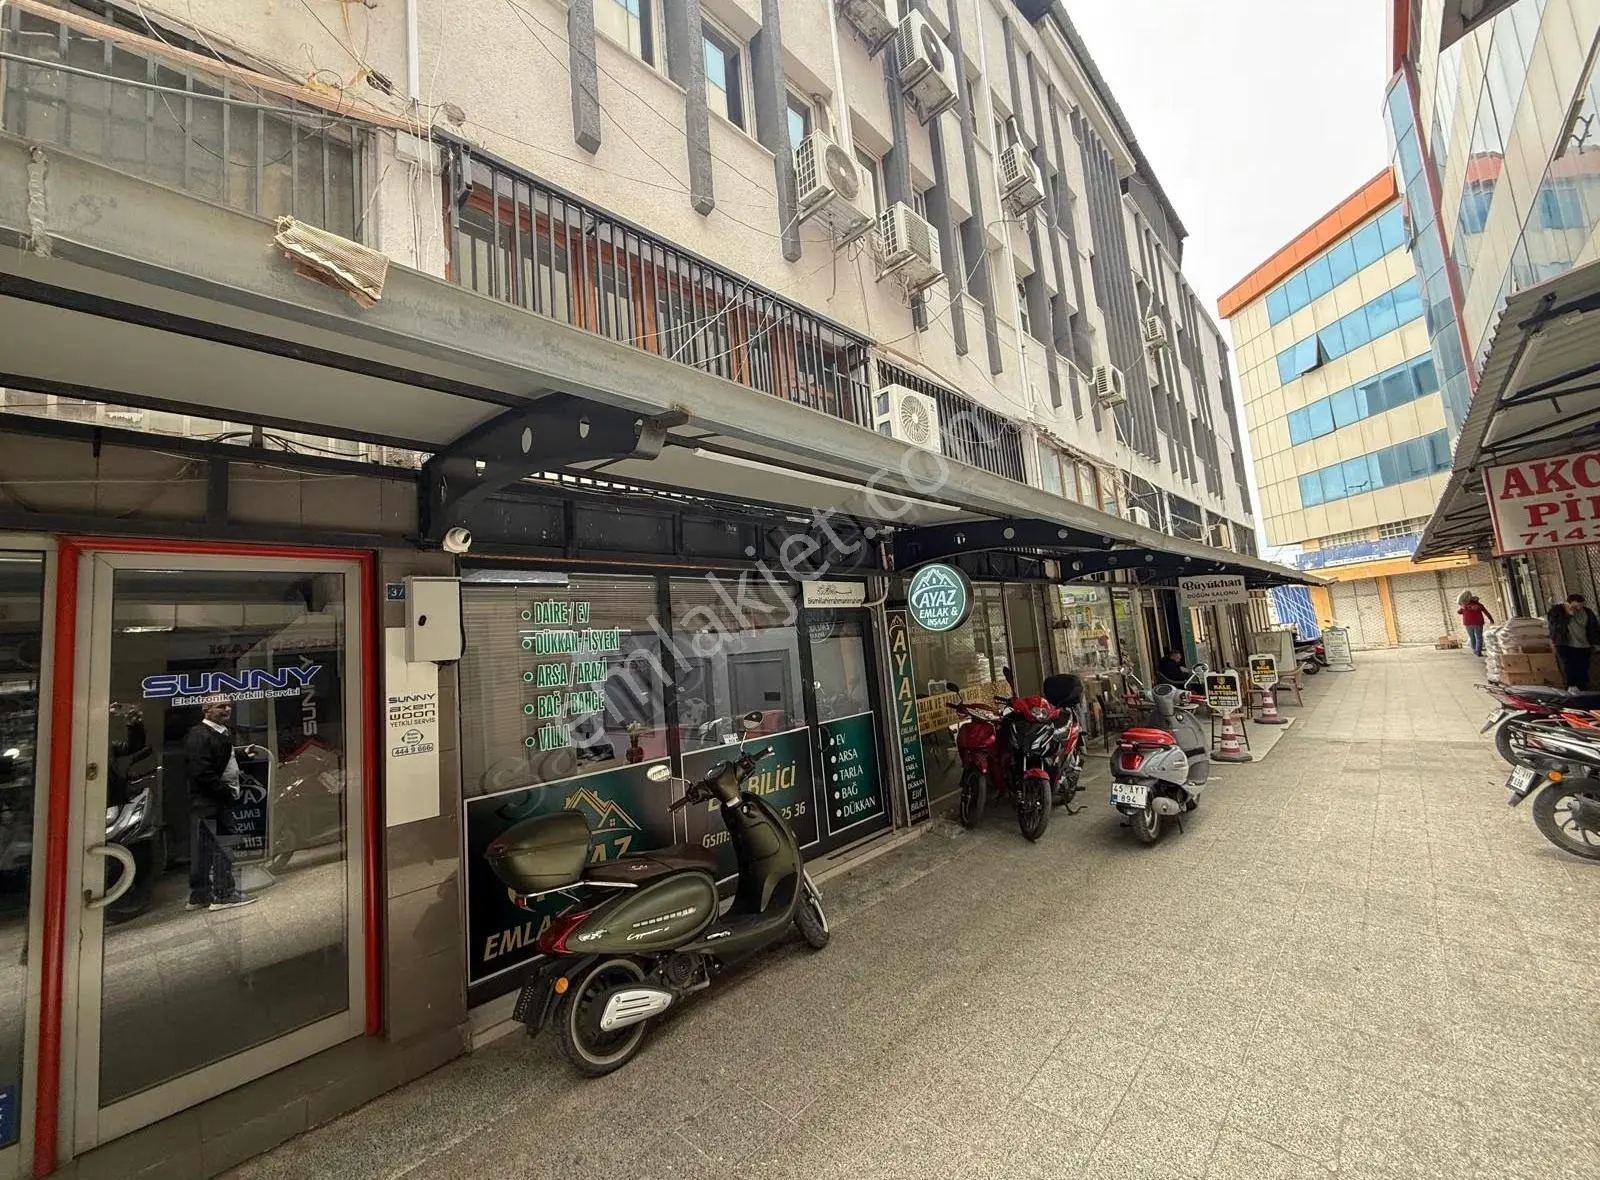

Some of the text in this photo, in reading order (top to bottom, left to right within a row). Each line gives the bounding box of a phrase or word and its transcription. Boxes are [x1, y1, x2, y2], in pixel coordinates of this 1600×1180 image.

[919, 589, 956, 609] AYAZ
[534, 599, 568, 625] DAİRE
[576, 602, 590, 623] EV
[919, 606, 958, 619] EMLAK &
[536, 629, 579, 655] DÜKKAN
[588, 627, 620, 654] İŞYERİ
[142, 665, 322, 698] SUNNY
[537, 663, 568, 688] ARSA
[577, 657, 608, 684] ARAZİ
[893, 629, 914, 725] AYAZ
[171, 687, 301, 707] Elektronik Yetkili Servisi
[388, 693, 435, 704] SUNNY
[538, 691, 561, 720] BAĞ
[570, 690, 605, 715] BAHÇE
[538, 723, 572, 752] VİLLA
[836, 732, 846, 745] EV
[838, 748, 858, 763] ARSA
[747, 760, 796, 796] BİLİCİ
[840, 764, 863, 780] TARLA
[841, 781, 858, 799] BAĞ
[793, 801, 806, 817] 36
[843, 795, 876, 817] DÜKKAN
